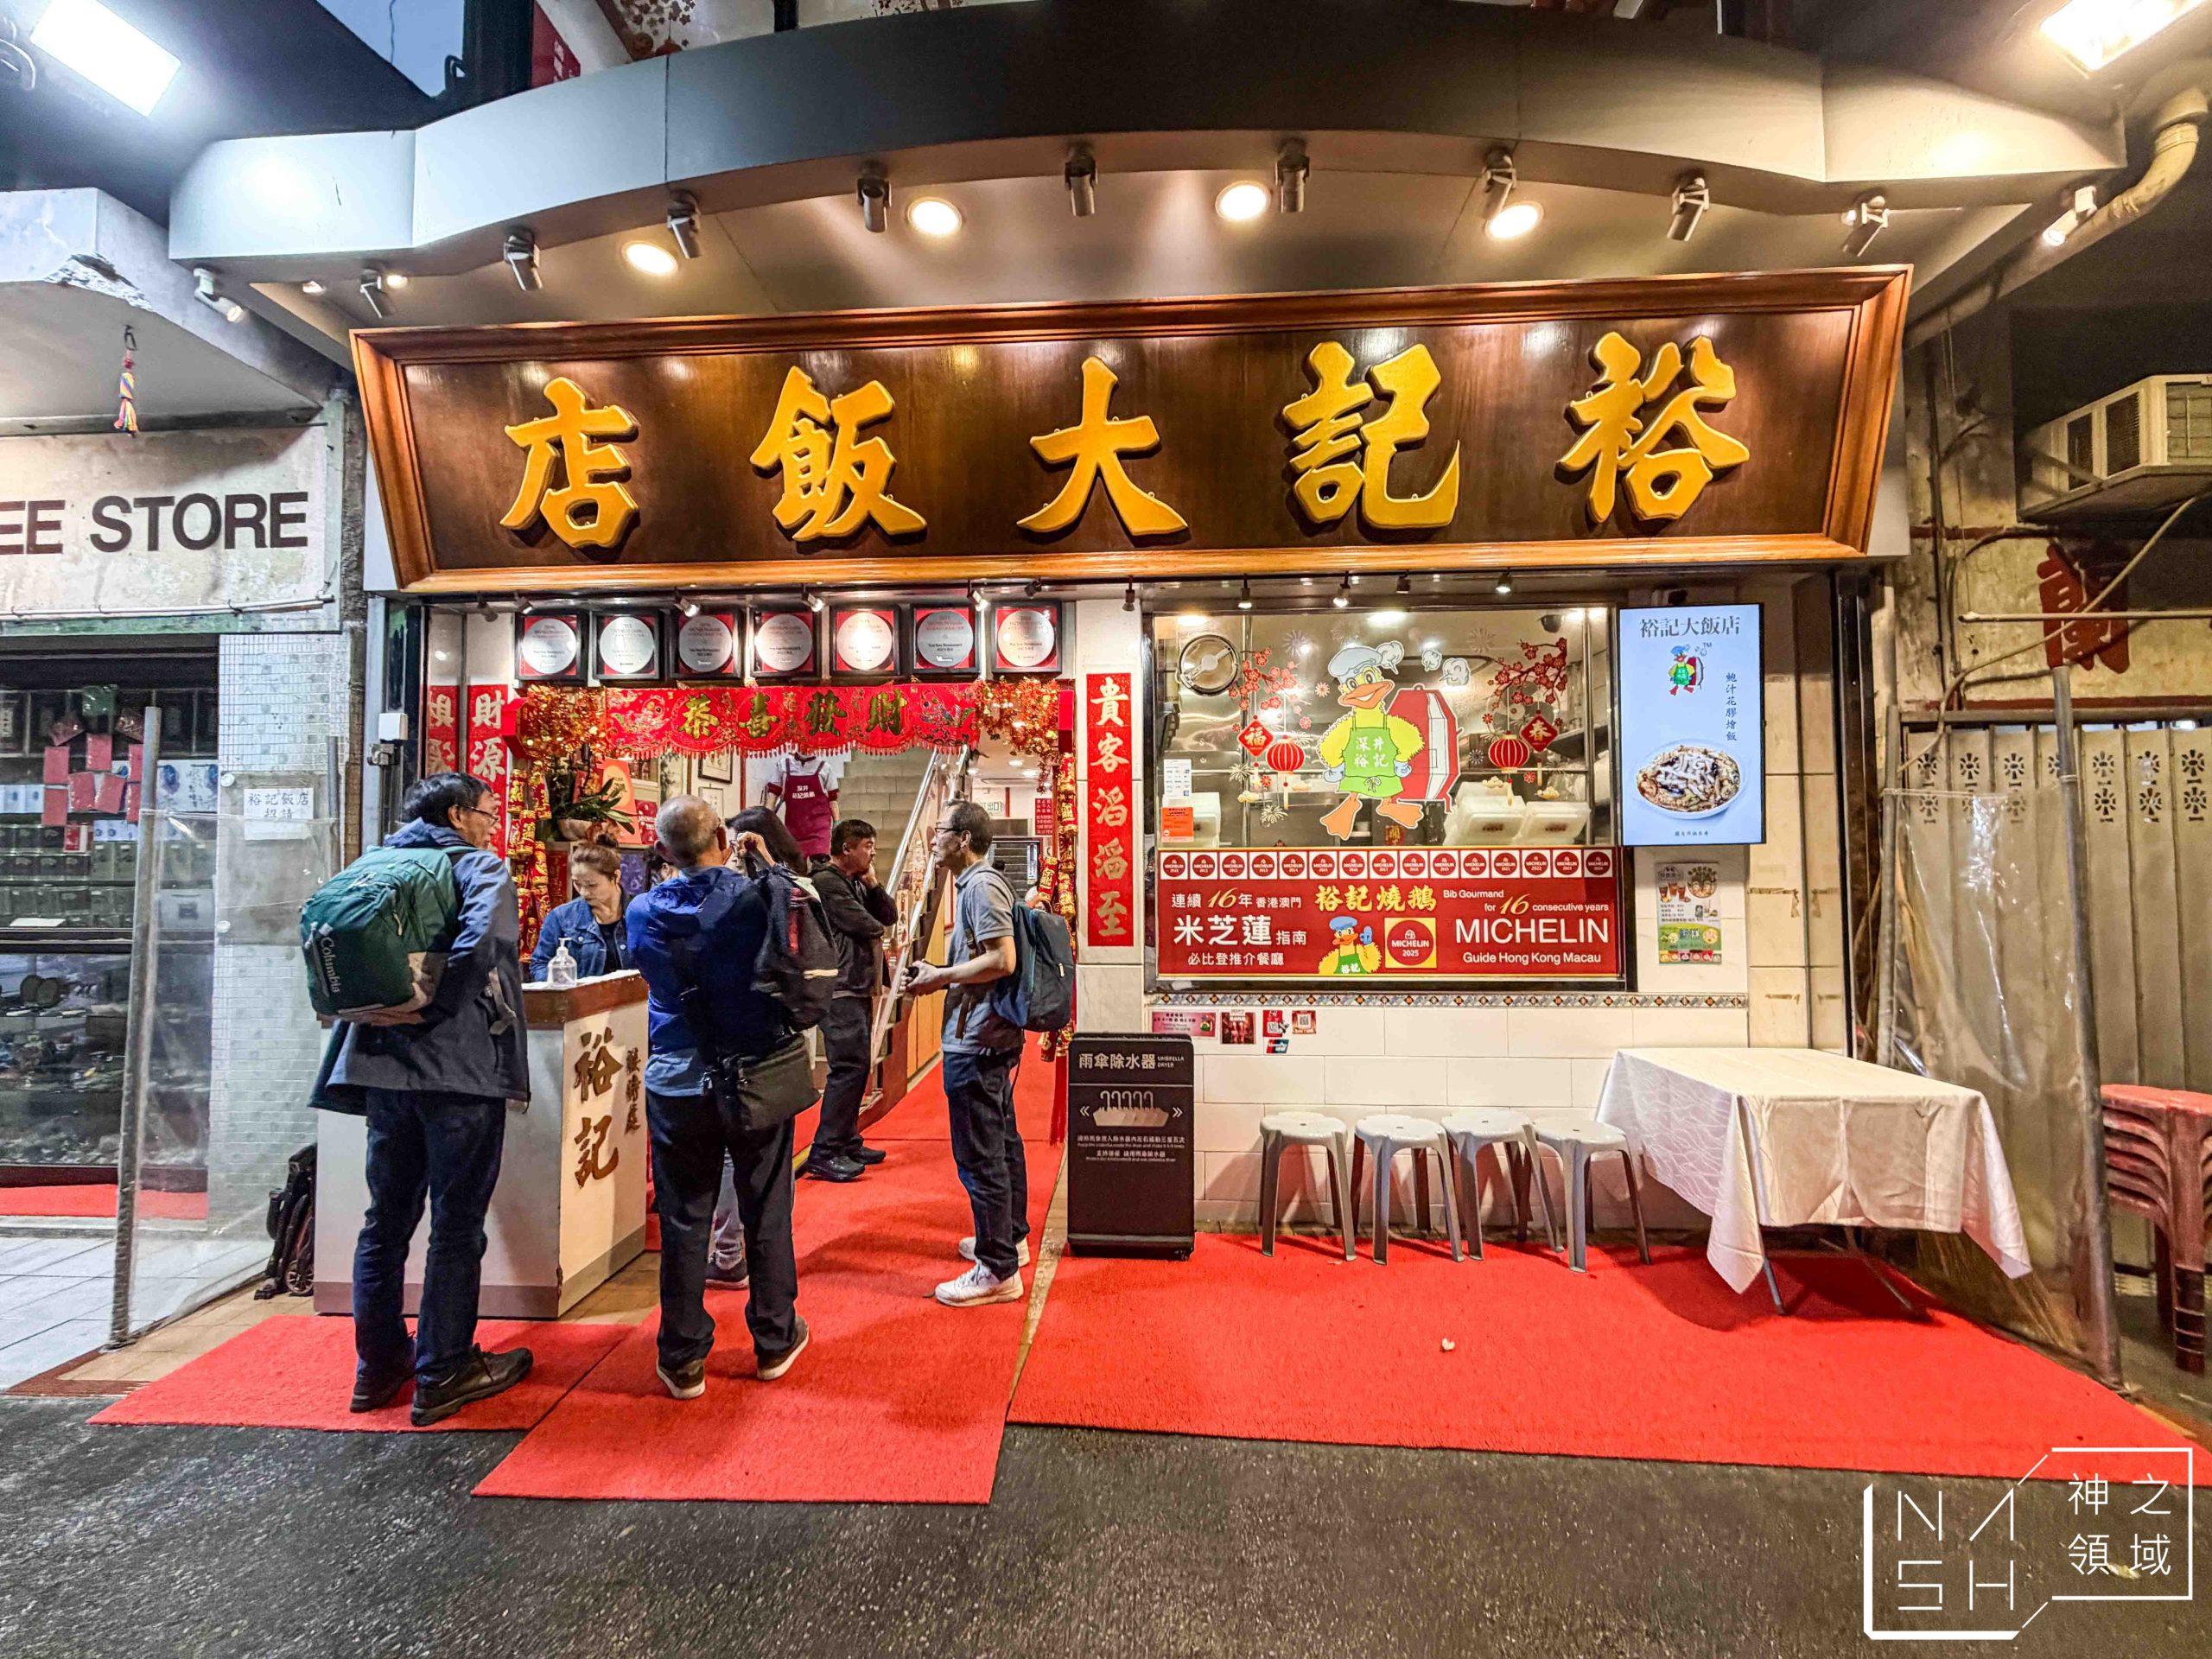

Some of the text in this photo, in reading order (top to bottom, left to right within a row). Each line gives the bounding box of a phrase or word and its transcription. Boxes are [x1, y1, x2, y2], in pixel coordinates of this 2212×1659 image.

[499, 332, 1751, 550] 裕記大飯店
[90, 492, 308, 553] STORE
[1640, 615, 1740, 638] 裕記大飯店
[1244, 726, 1268, 747] 福
[1529, 719, 1553, 741] 春
[1356, 736, 1384, 752] 深井
[1354, 753, 1389, 768] 裕記
[248, 791, 309, 806] 裕記飯店
[1090, 677, 1129, 937] 貴客滔滔至
[1255, 897, 1301, 909] 香港澳門
[1314, 884, 1437, 912] 裕記燒鵝
[1443, 889, 1504, 899] Bib Gourmand
[1484, 893, 1609, 915] for 16 consecutive years
[1173, 914, 1307, 946] 米芝蓮 指南
[1456, 918, 1609, 944] MICHELIN
[1391, 939, 1430, 948] MICHELIN
[1402, 949, 1420, 957] 2025
[321, 937, 341, 994] Columbia
[1188, 952, 1285, 966] 必比登推介餐廳
[1340, 963, 1361, 974] 裕記
[1463, 952, 1601, 966] Guide Hong Kong Macau
[1078, 1052, 1156, 1070] 雨傘除水器
[574, 1027, 624, 1189] 裕記
